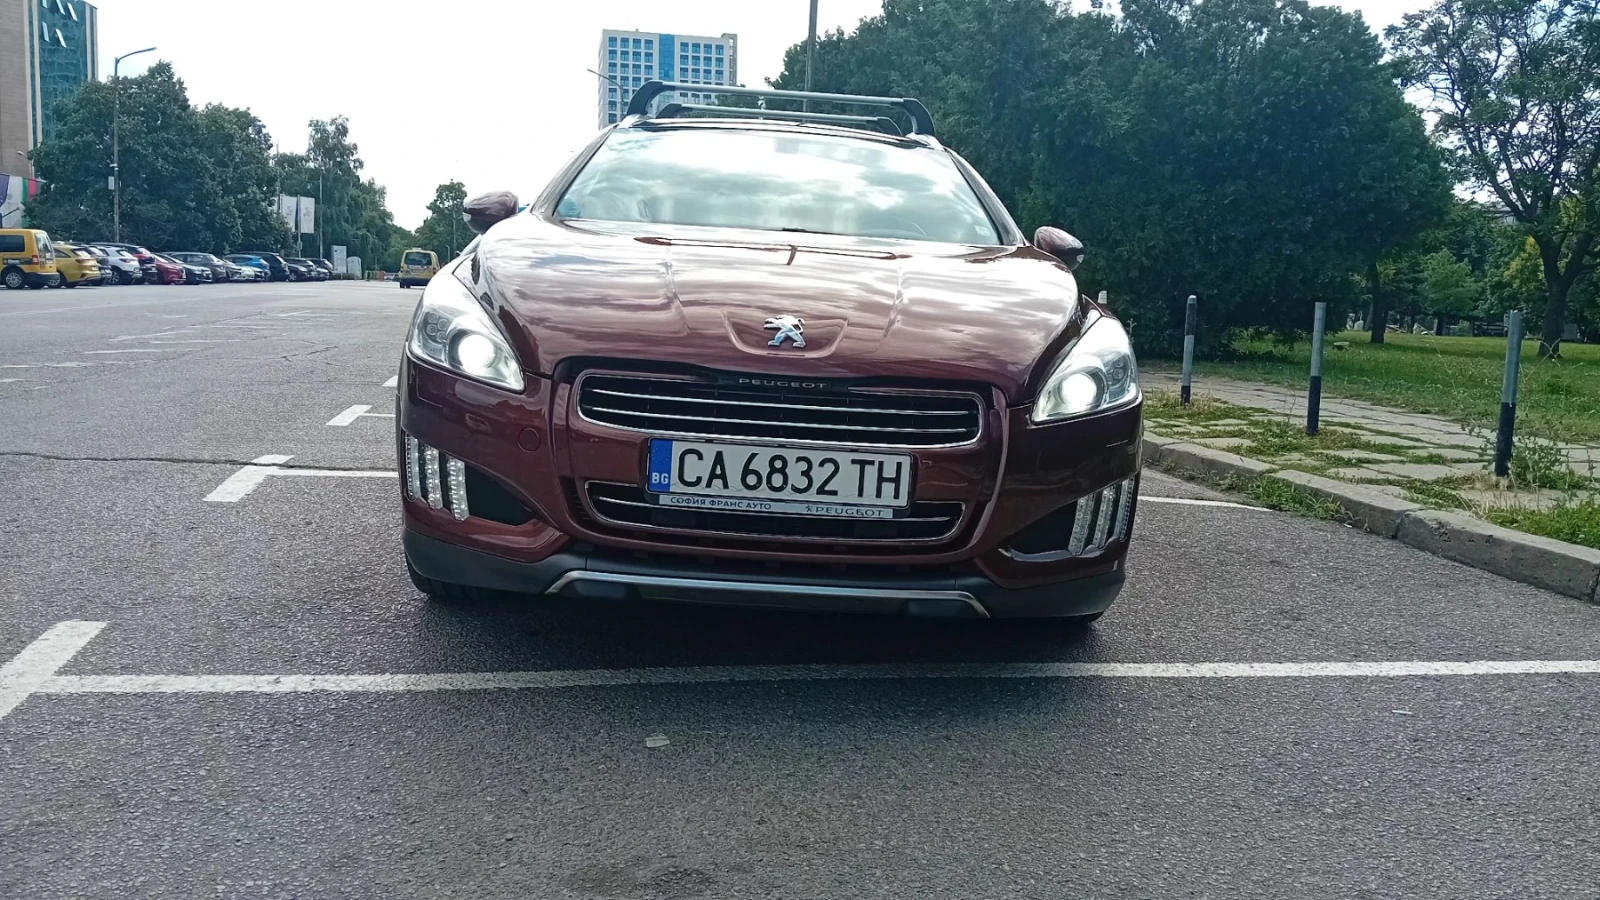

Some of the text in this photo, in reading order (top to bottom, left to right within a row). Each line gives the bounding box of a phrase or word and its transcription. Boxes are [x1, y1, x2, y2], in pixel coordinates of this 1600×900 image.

[739, 378, 828, 389] PEUGEOT
[652, 472, 669, 485] BG
[677, 448, 903, 500] CA 6832 TH
[670, 496, 772, 510] СОФИЯ ФРАНС АУТО
[815, 506, 884, 517] PEUGEOT
